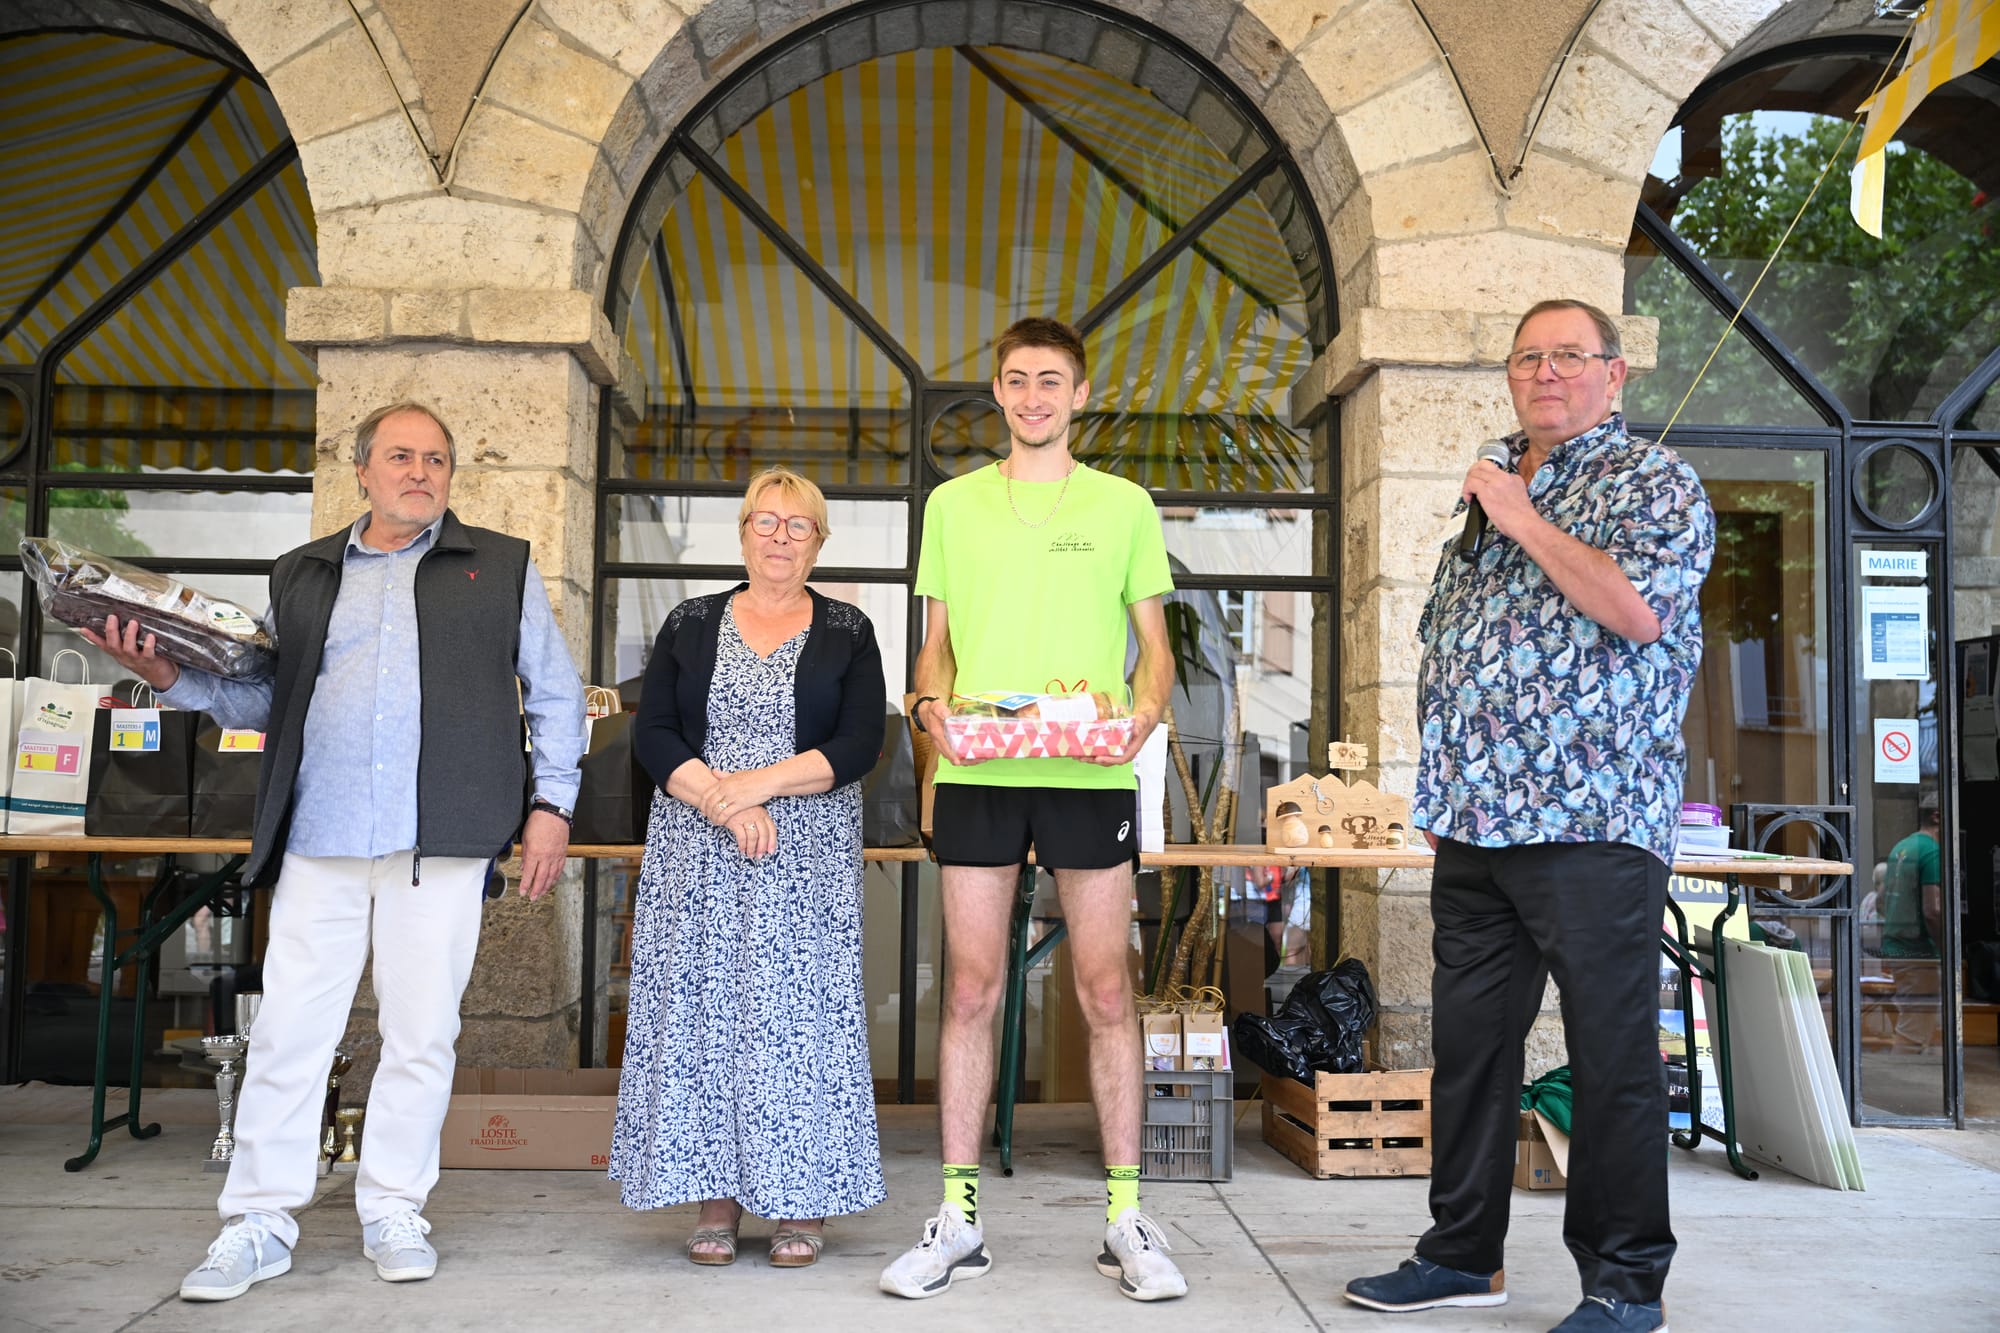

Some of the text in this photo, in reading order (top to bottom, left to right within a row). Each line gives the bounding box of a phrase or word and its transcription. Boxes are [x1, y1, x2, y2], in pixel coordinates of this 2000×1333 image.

[1868, 557, 1918, 570] MAIRIE
[116, 733, 126, 747] 1
[145, 729, 156, 743] M
[227, 735, 237, 748] 1
[23, 753, 34, 769] 1
[63, 753, 73, 766] F
[481, 1128, 517, 1138] LOSTE
[469, 1138, 529, 1146] TRADI-FRANCE
[591, 1154, 611, 1165] BA
